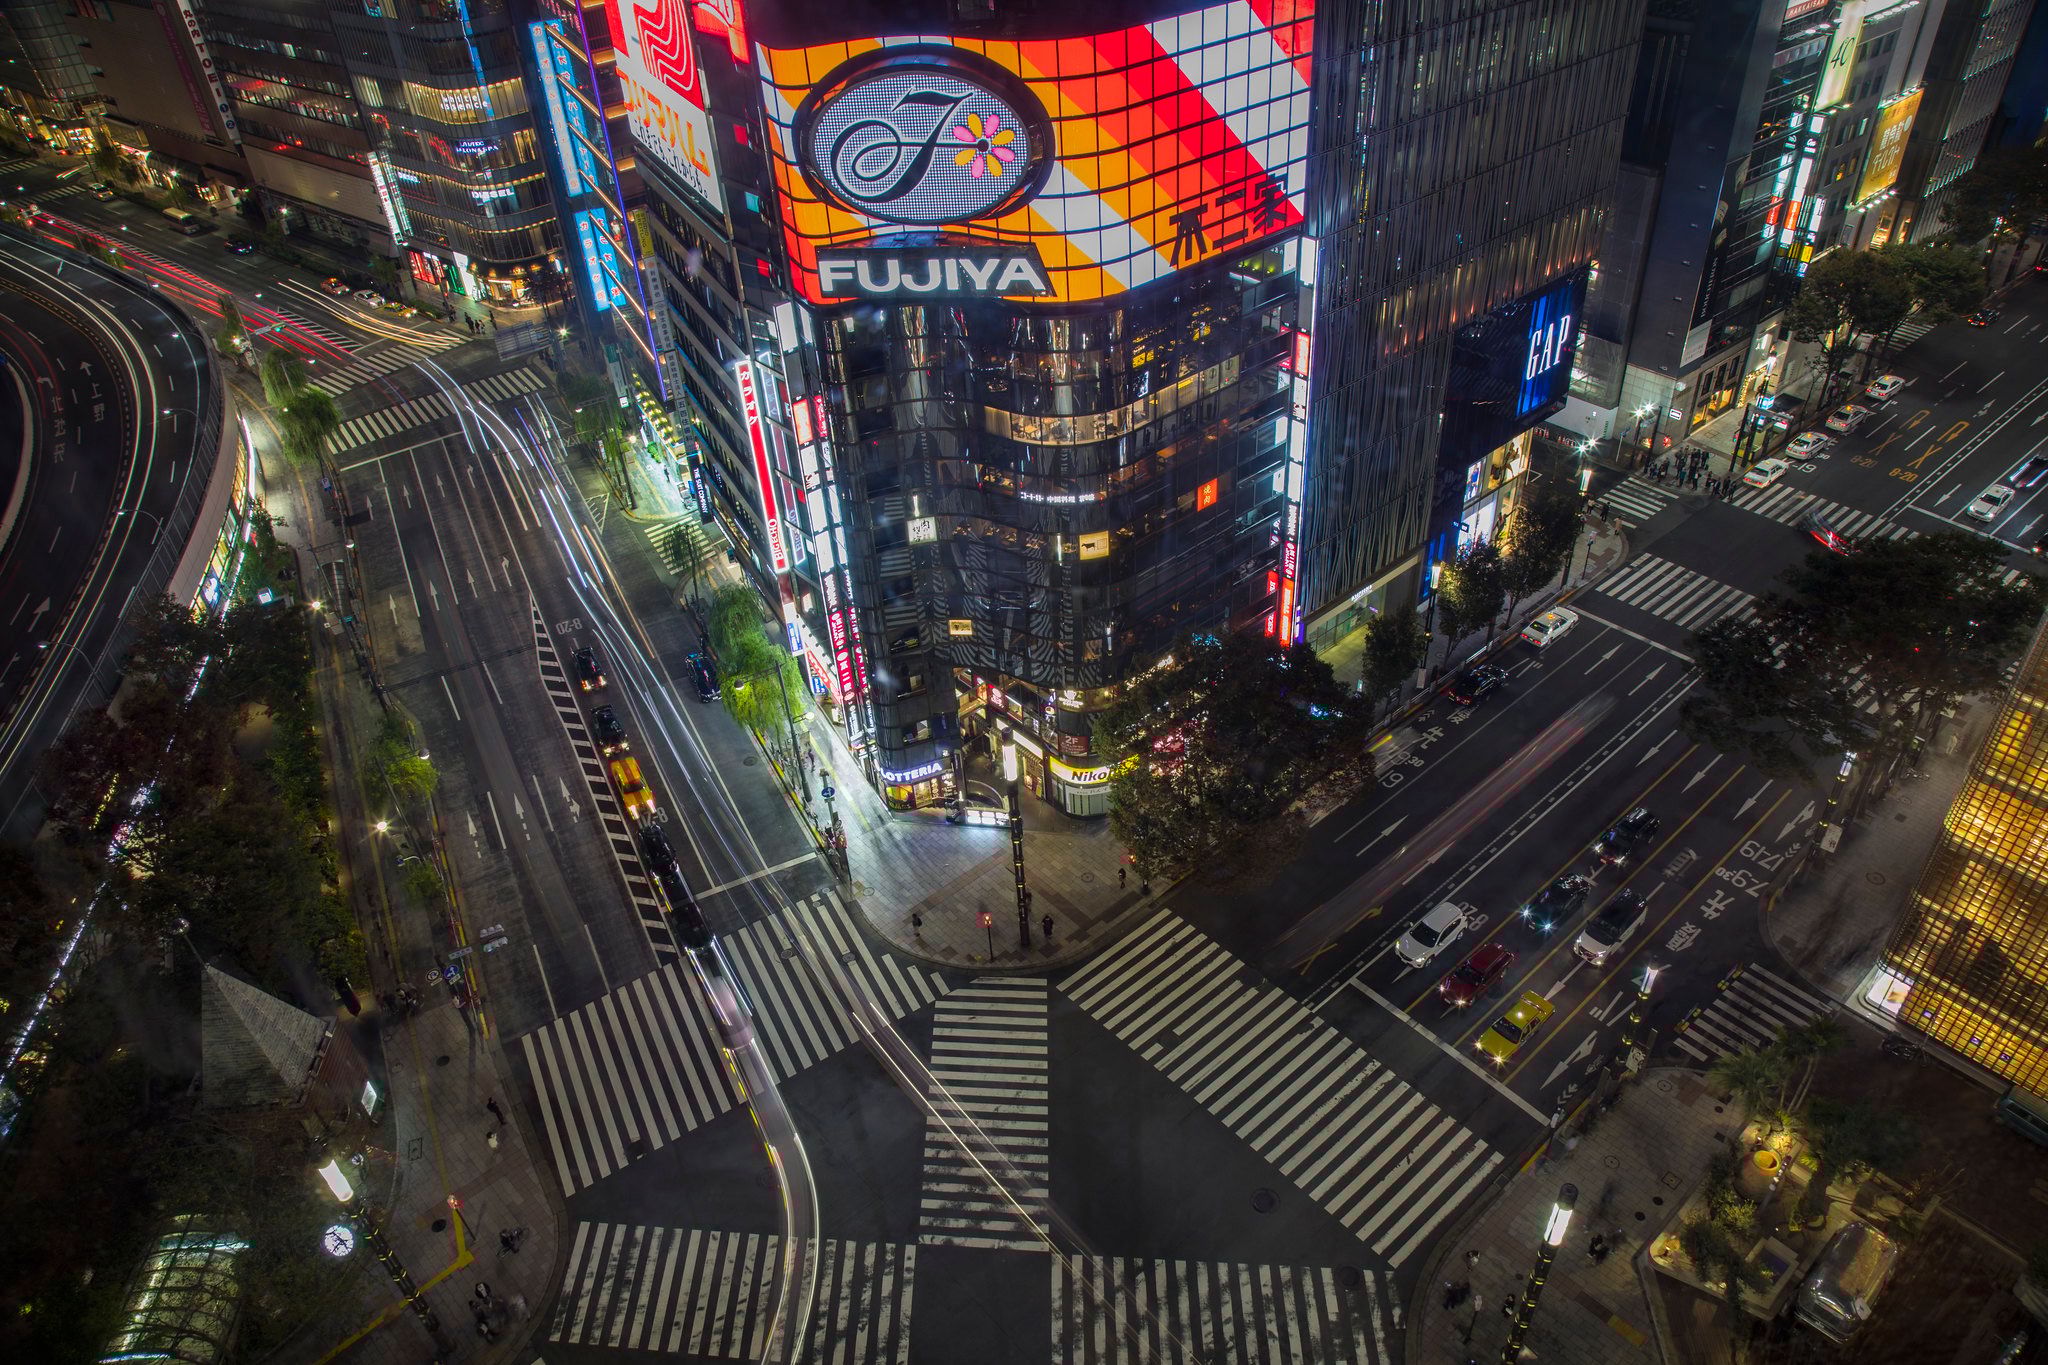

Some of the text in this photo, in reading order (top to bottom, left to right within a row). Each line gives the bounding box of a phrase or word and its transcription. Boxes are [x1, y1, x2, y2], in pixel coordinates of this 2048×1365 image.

[471, 189, 515, 199] DIESEL
[1169, 173, 1288, 267] 不二家
[820, 257, 1046, 293] FUJIYA
[1526, 315, 1571, 381] GAP
[740, 371, 759, 425] カラオケ
[1888, 467, 1919, 483] 8-20
[555, 617, 583, 636] 8-20
[1065, 735, 1079, 745] 2F
[880, 762, 942, 782] LOTTERIA
[1071, 771, 1108, 782] Niko
[1739, 840, 1785, 872] 17-19
[1715, 867, 1770, 898] 7-9.30
